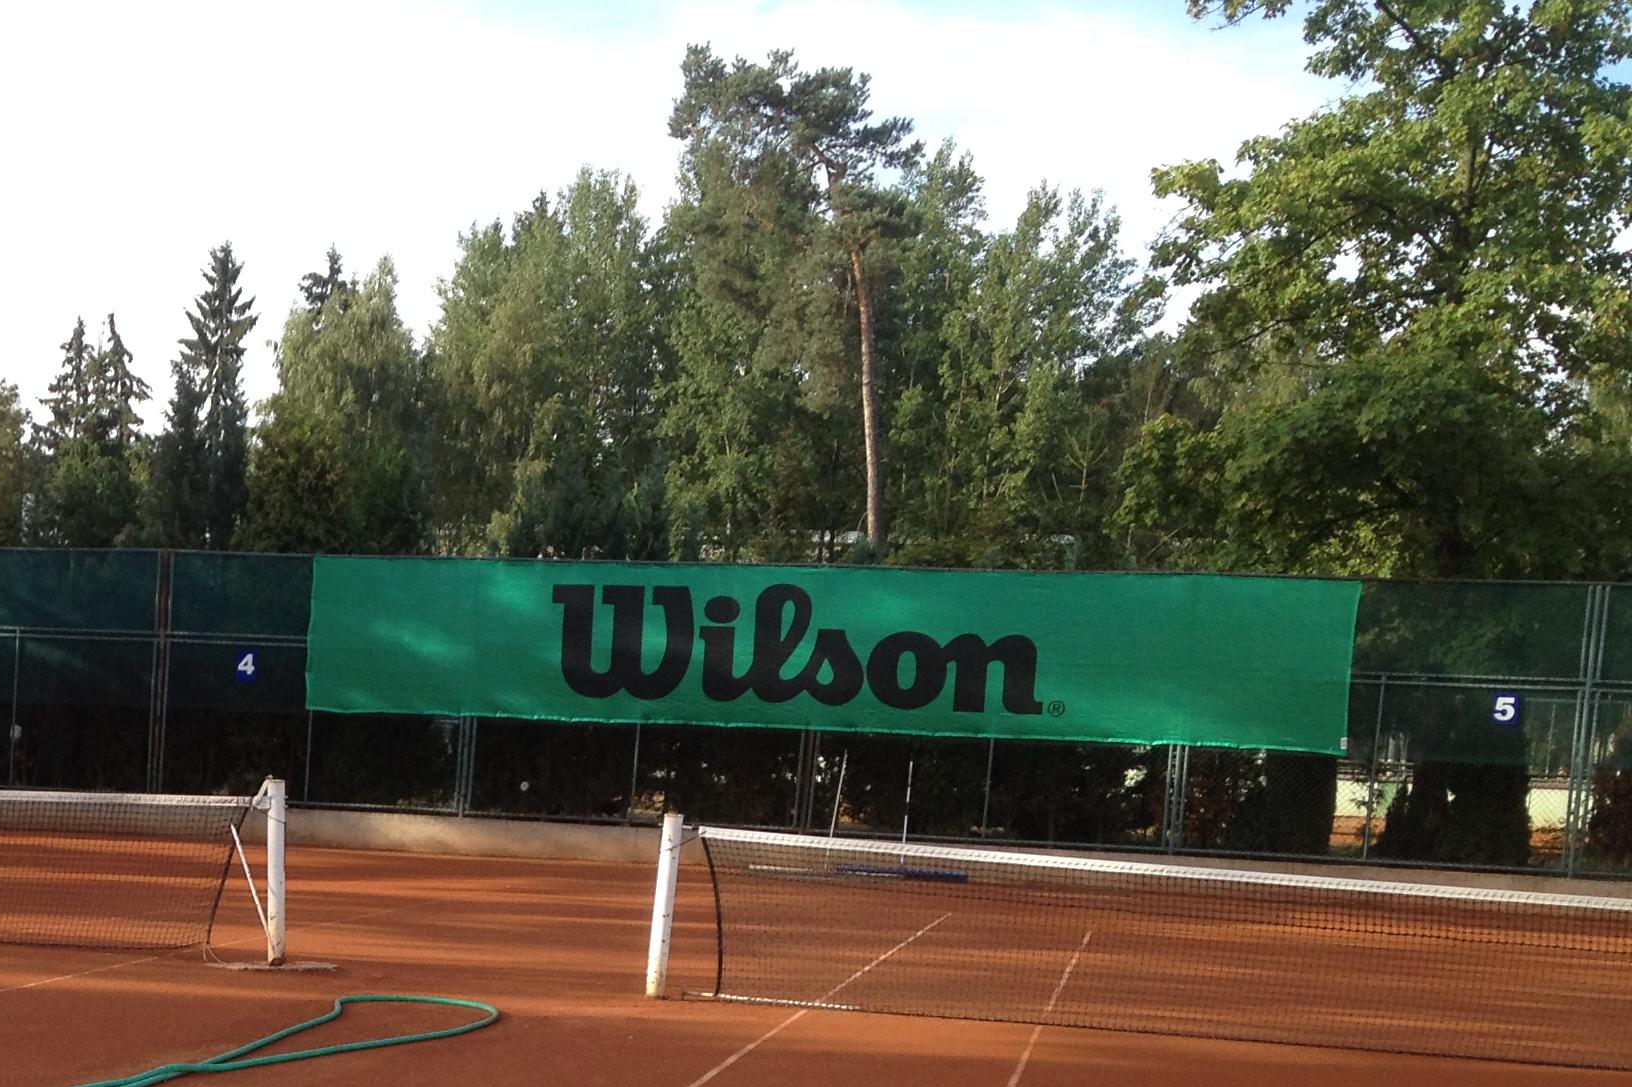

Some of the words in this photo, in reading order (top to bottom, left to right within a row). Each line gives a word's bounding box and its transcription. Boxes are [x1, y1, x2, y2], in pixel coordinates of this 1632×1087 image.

[552, 583, 1043, 713] Wilson
[237, 653, 255, 675] 4
[1493, 696, 1515, 721] 5
